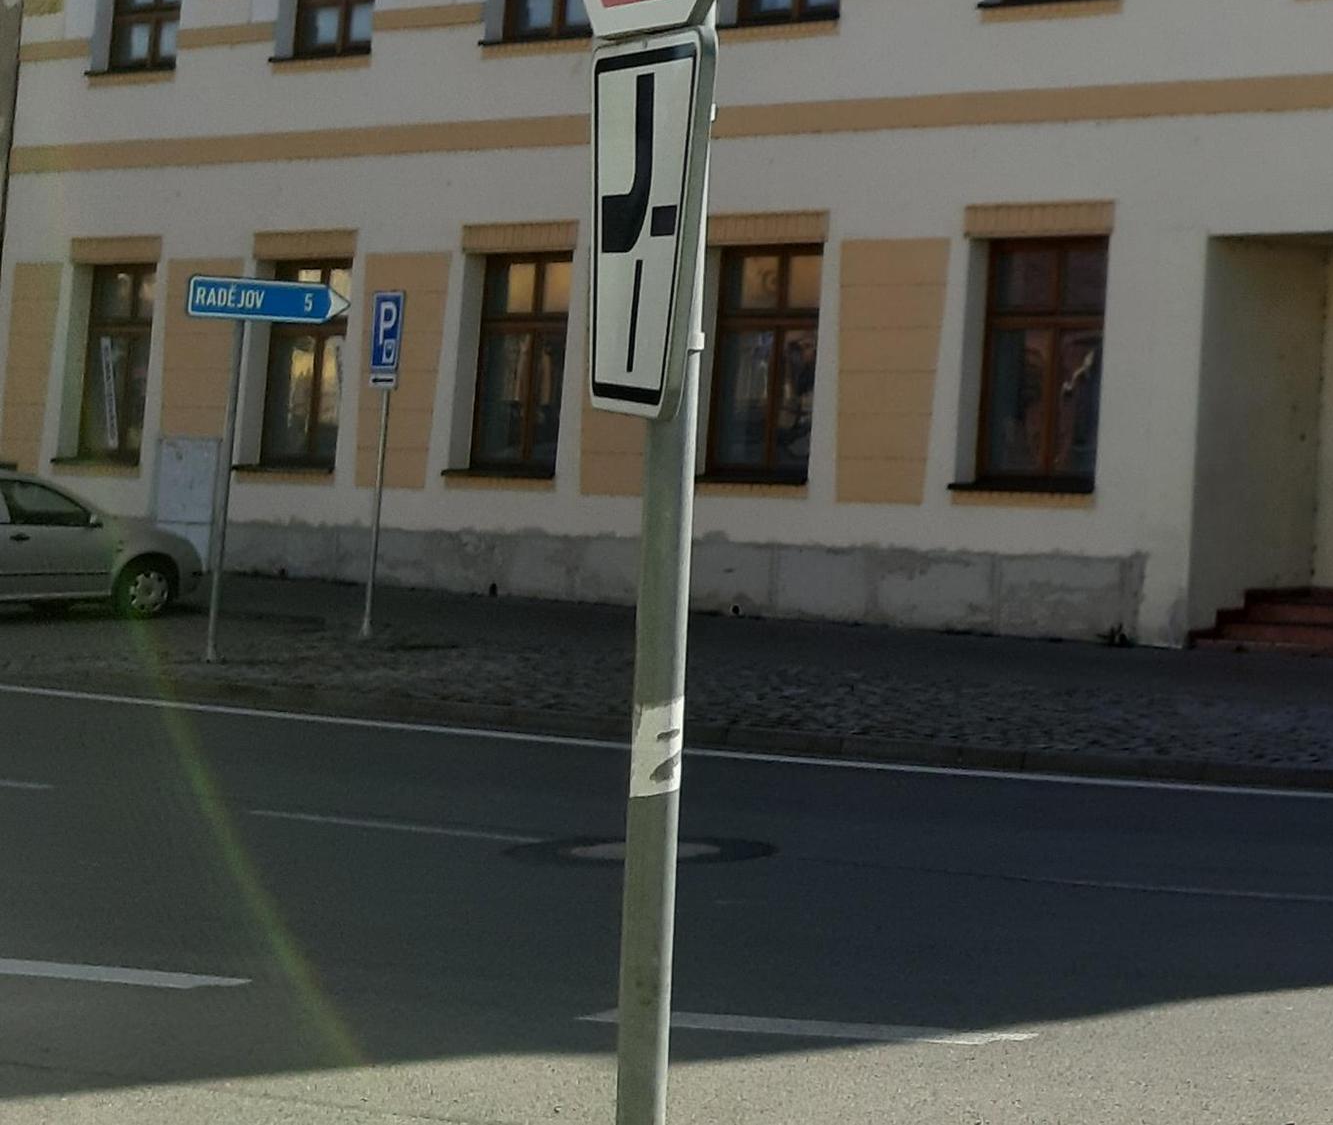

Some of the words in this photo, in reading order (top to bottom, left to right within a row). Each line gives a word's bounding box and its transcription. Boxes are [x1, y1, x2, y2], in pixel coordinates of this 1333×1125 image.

[196, 284, 264, 309] RADĚJOV
[304, 293, 313, 312] 5
[379, 301, 397, 345] P
